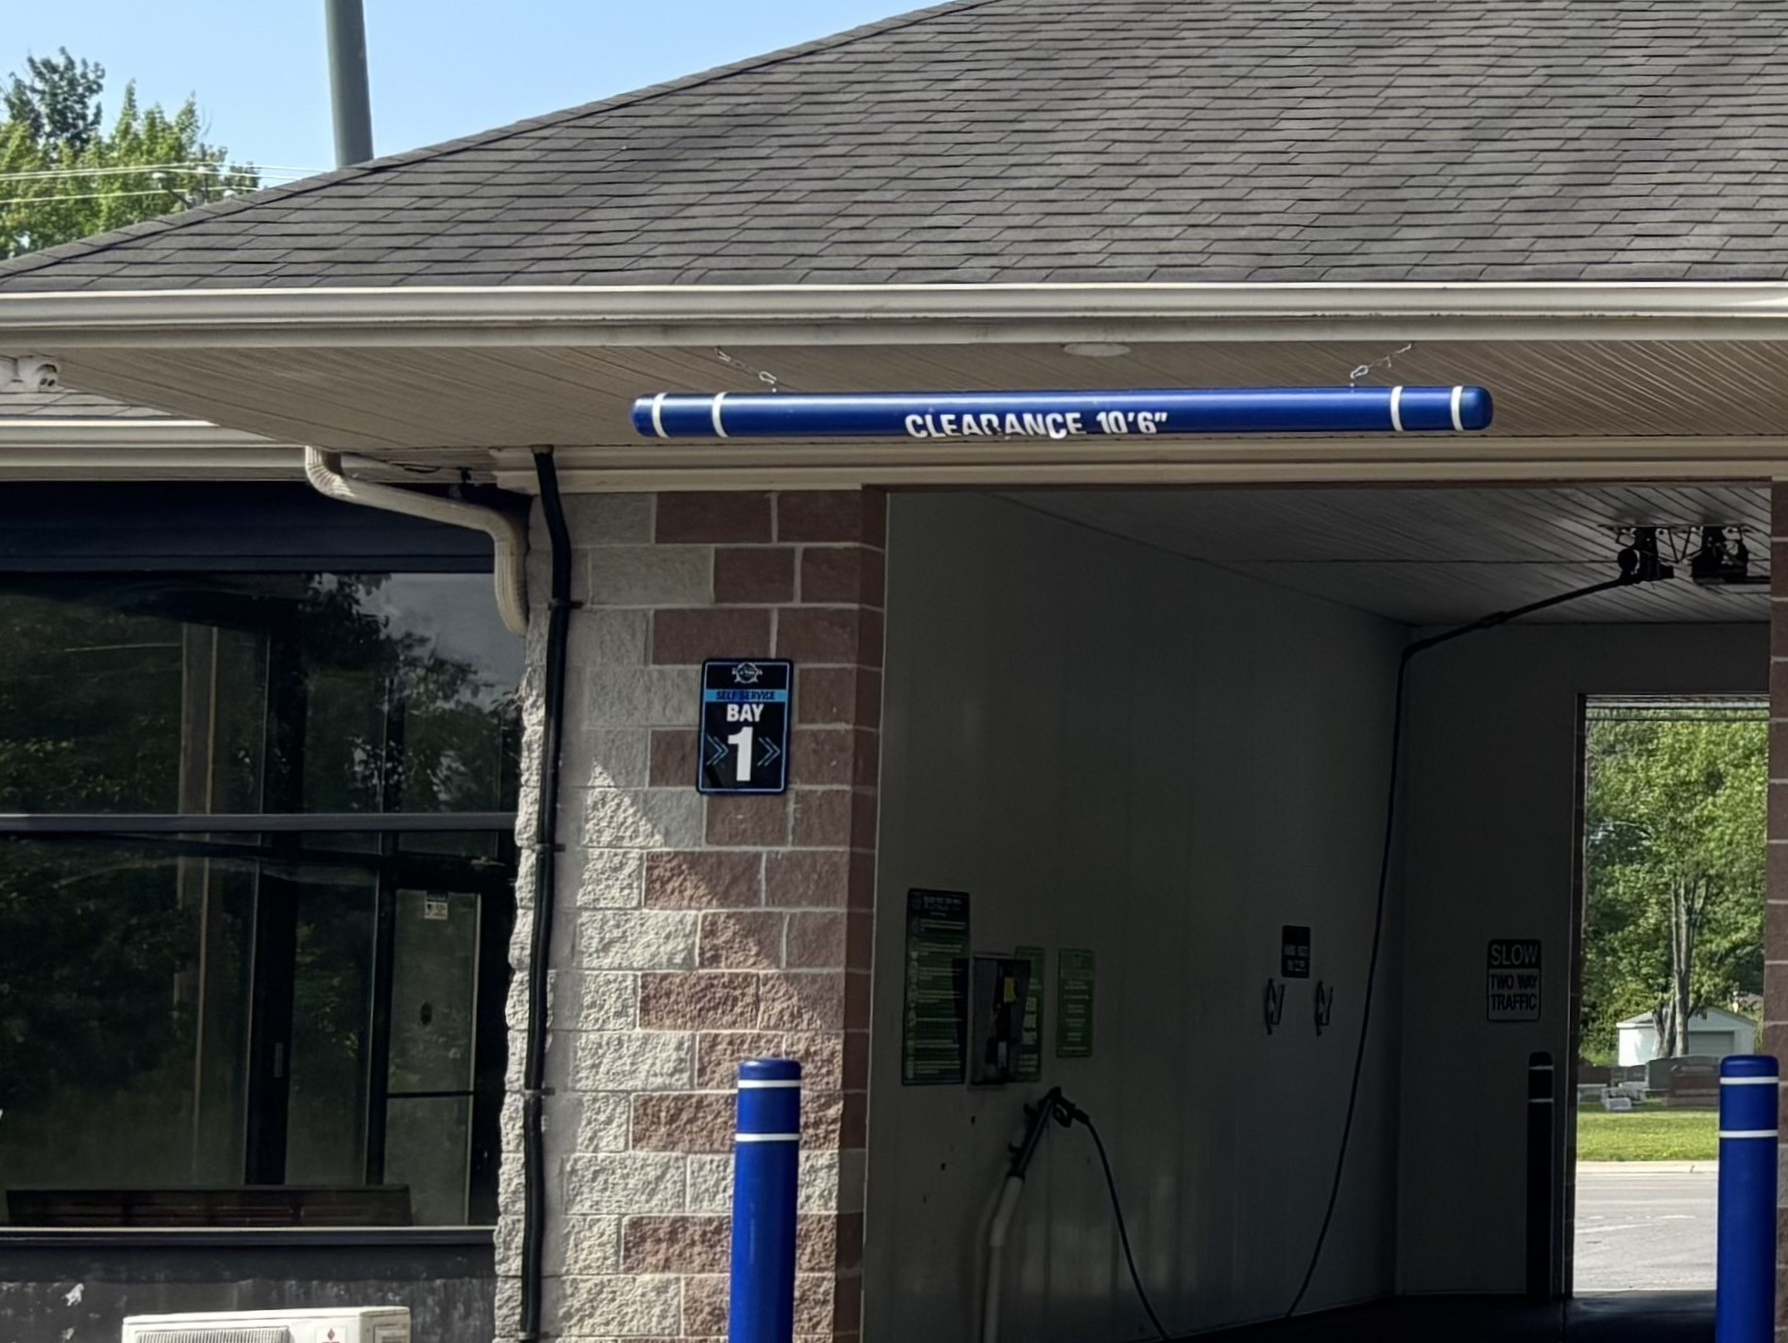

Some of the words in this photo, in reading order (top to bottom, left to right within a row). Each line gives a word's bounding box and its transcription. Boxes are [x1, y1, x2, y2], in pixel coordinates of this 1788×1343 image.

[904, 412, 1087, 439] CLEARANCE
[1096, 411, 1168, 434] 10'6"
[726, 703, 764, 722] BAY
[727, 726, 753, 781] 1
[1490, 944, 1538, 965] SLOW
[1491, 974, 1514, 989] TWO
[1491, 993, 1537, 1011] TRAFFIC
